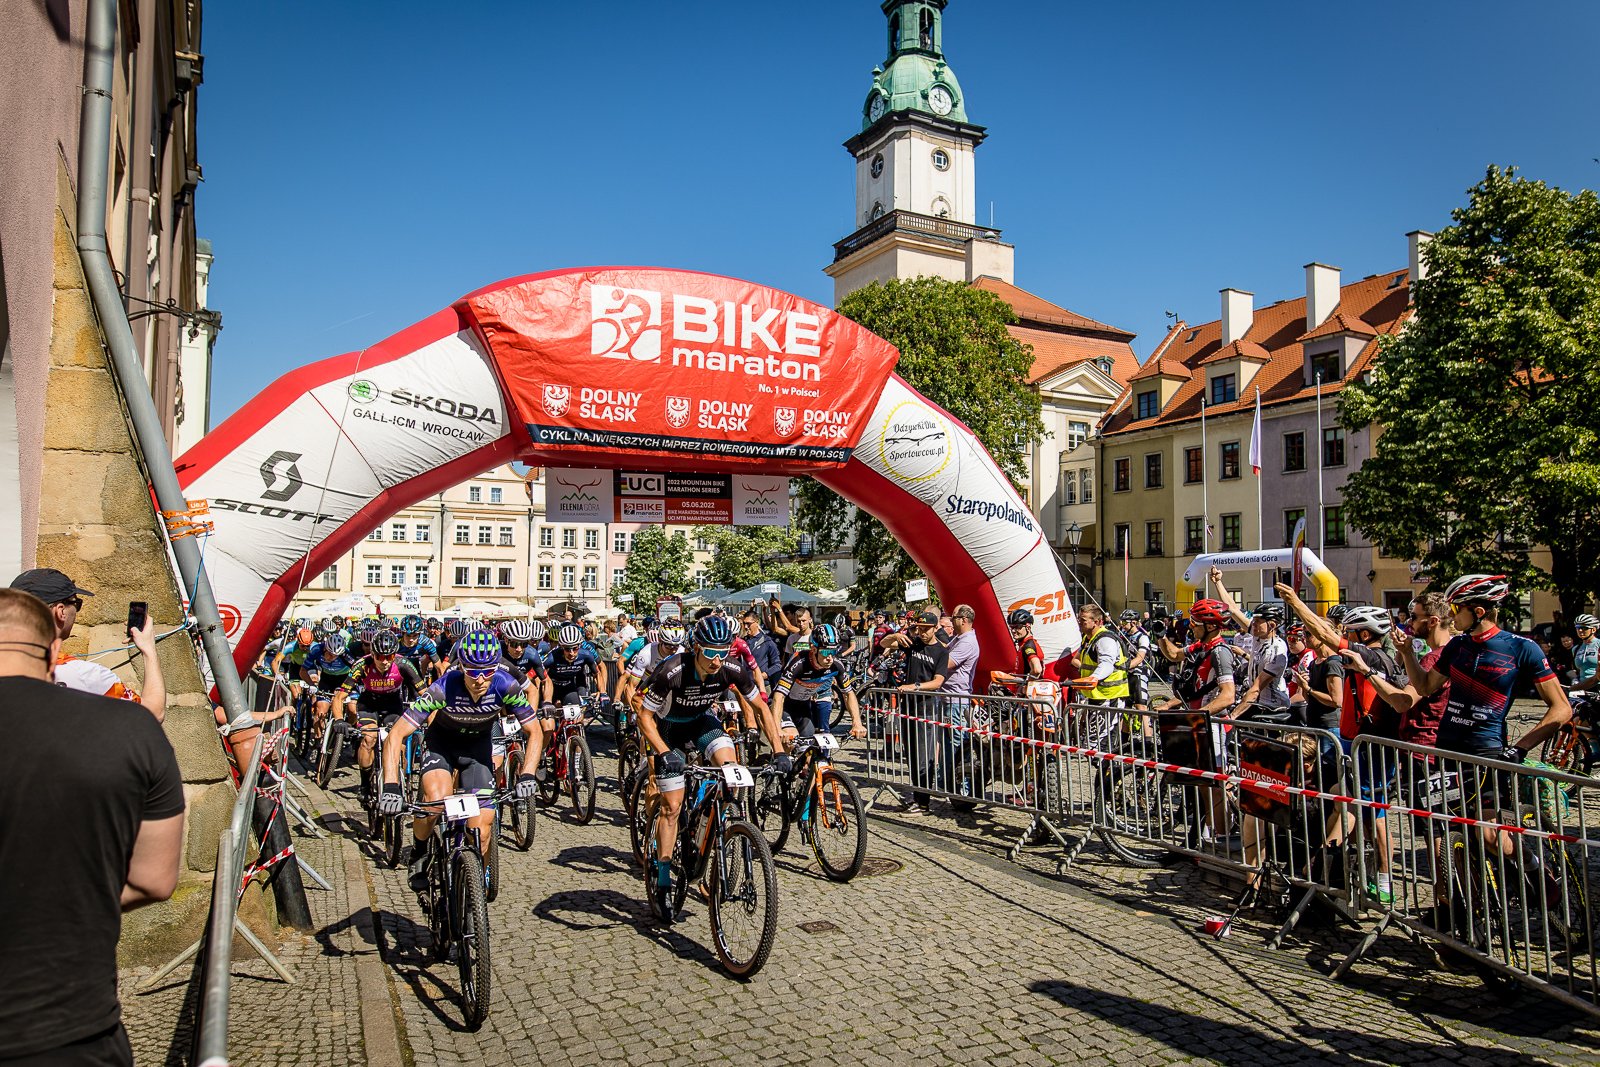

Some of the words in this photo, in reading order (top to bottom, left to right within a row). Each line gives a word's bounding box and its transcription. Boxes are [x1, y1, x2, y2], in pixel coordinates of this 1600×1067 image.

[673, 294, 821, 358] BIKE
[672, 347, 821, 382] maraton
[580, 387, 642, 408] DOLNY
[758, 384, 773, 394] No.
[774, 386, 779, 394] 1
[782, 388, 790, 396] w
[791, 388, 820, 398] Polsce!
[389, 387, 497, 425] ŠKODA
[579, 402, 638, 422] ŚLĄSK
[699, 399, 753, 418] DOLNY
[352, 408, 416, 429] GALL-ICM
[422, 421, 485, 442] WROCŁAW
[698, 411, 749, 432] ŚLĄSK
[804, 410, 852, 425] DOLNY
[802, 421, 848, 439] ŚLĄSK
[540, 430, 571, 441] CYKL
[574, 432, 660, 448] NAJWIĘKSZYCH
[662, 439, 701, 451] IMPREZ
[702, 442, 774, 456] ROWEROWYCH
[776, 448, 796, 456] MTB
[798, 448, 808, 458] W
[628, 478, 661, 492] UCI
[209, 498, 334, 524] SCOTT
[560, 503, 584, 511] JELENIA
[584, 502, 600, 512] GÓRA
[765, 507, 778, 515] GÓRA
[945, 495, 1033, 532] Staropolanka
[1212, 558, 1234, 566] Miasto
[1236, 556, 1260, 564] Jelenia
[1008, 590, 1066, 616] CST
[1042, 610, 1072, 624] TIRES
[446, 704, 502, 713] CANYON
[676, 696, 712, 707] Singer
[570, 707, 575, 716] 9
[1450, 716, 1476, 727] ROMET
[734, 769, 742, 781] 5
[459, 799, 465, 811] 1
